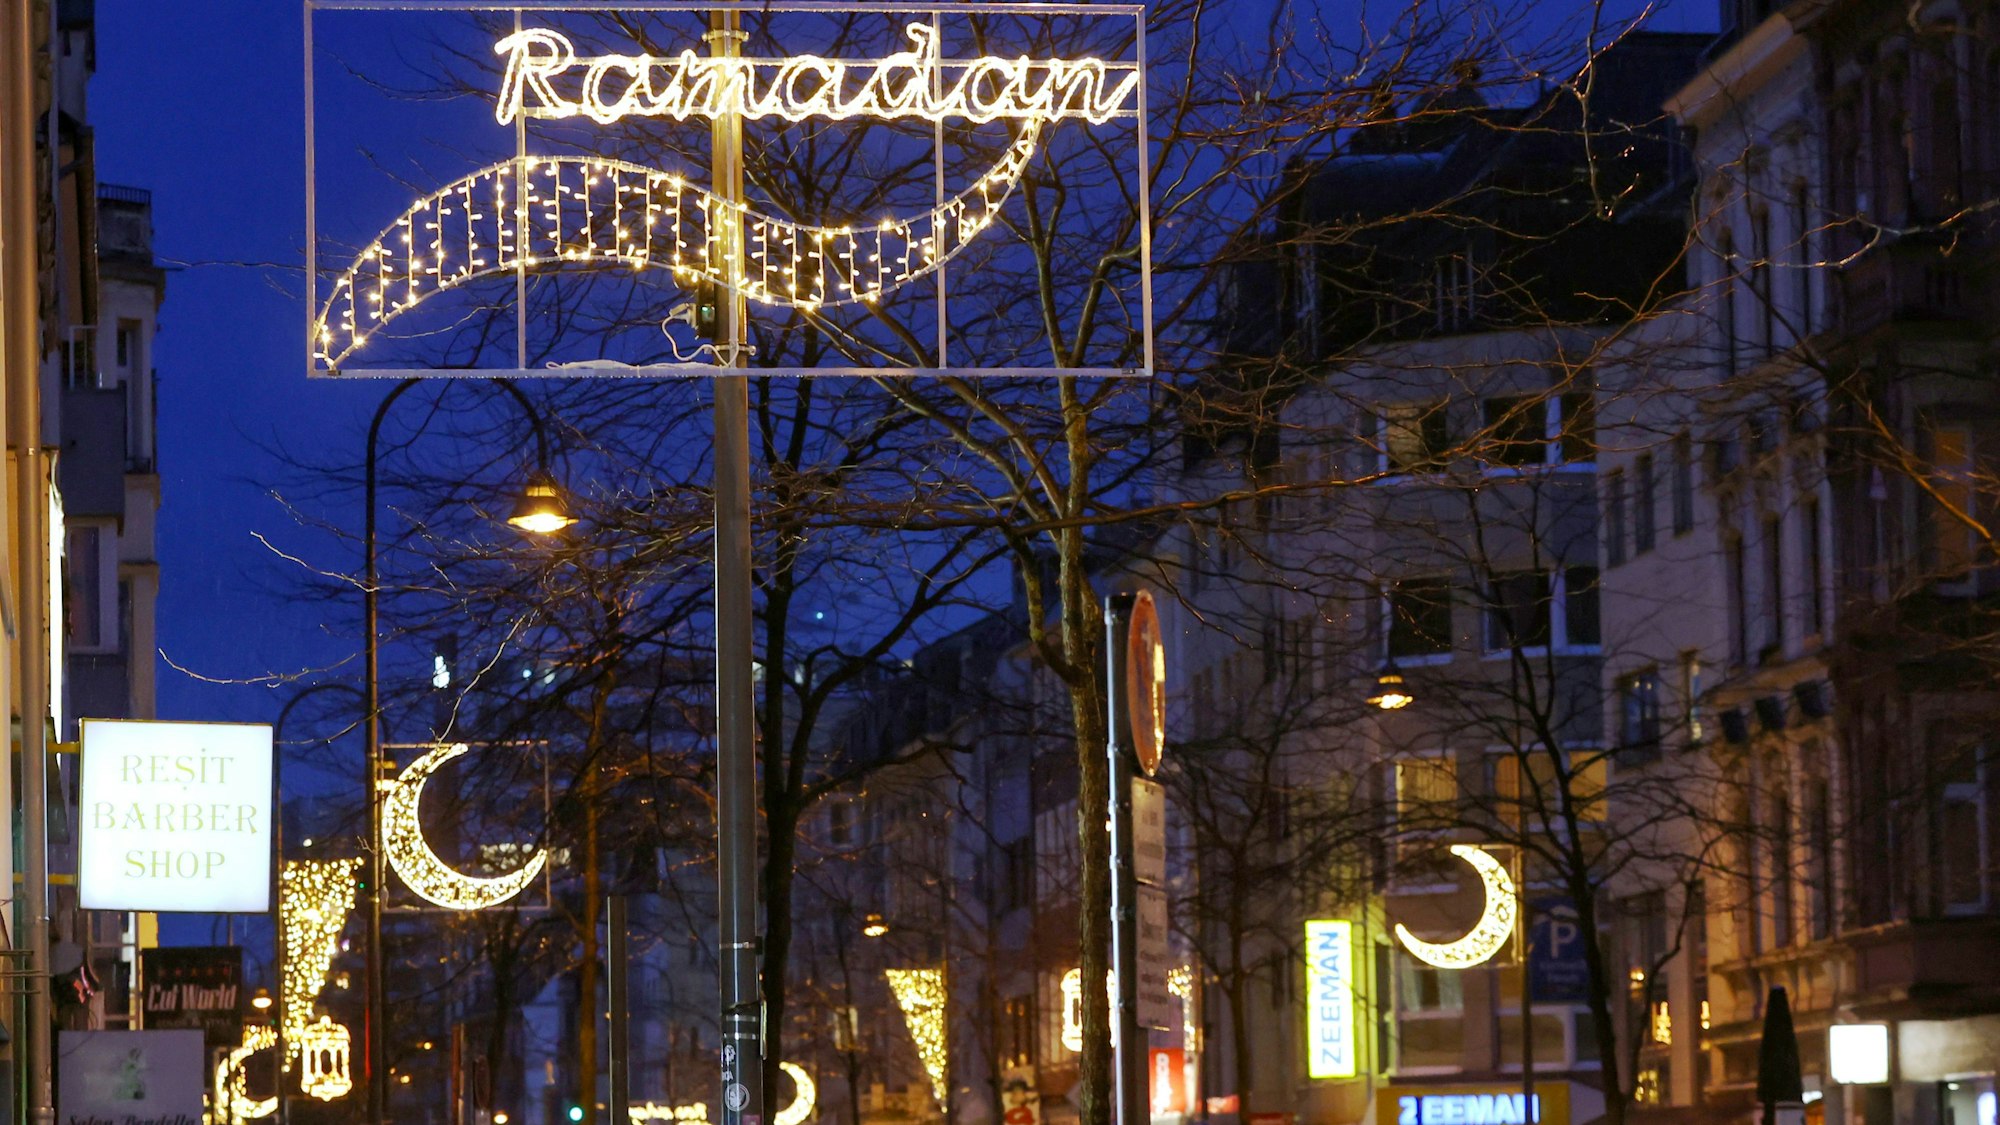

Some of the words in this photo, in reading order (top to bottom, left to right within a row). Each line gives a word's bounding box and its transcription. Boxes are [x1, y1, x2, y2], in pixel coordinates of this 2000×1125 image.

[494, 23, 1140, 125] Ramadan
[92, 801, 257, 834] BARBER
[124, 850, 225, 878] SHOP
[148, 984, 179, 1011] Cut
[182, 983, 237, 1011] World
[1319, 931, 1342, 1064] ZEEMAN
